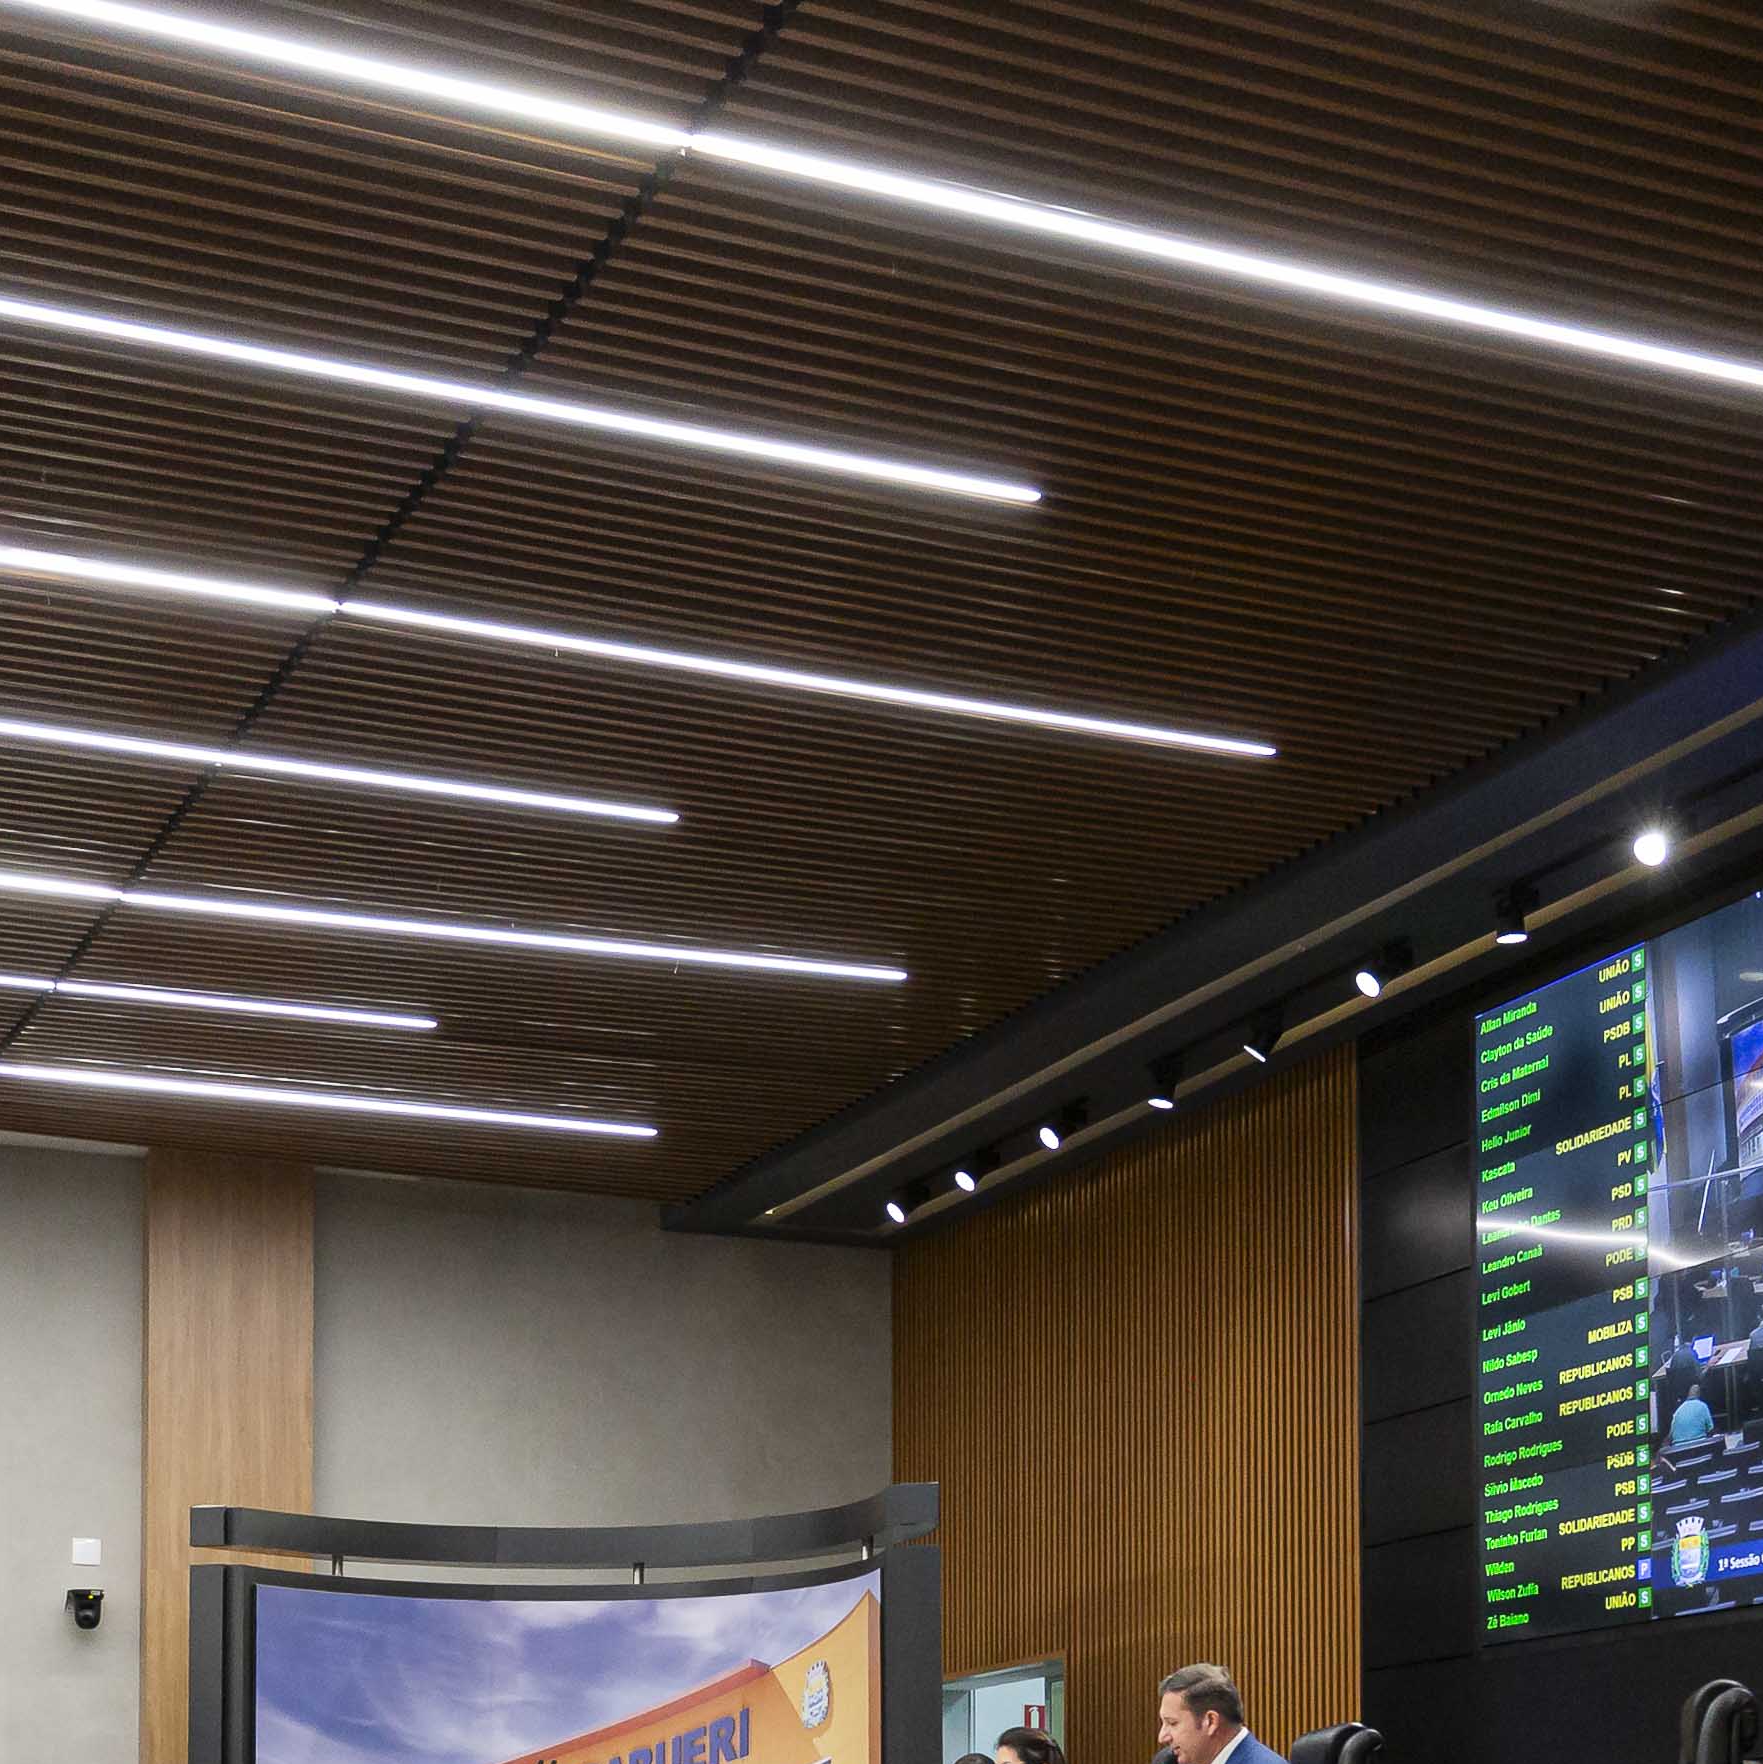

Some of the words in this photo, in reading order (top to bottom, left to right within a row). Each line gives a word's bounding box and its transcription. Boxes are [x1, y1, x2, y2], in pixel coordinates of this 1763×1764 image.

[1598, 959, 1629, 982] UNIÃO
[1599, 990, 1630, 1013] UNIÃO
[1503, 1001, 1538, 1025] Miranda
[1603, 1021, 1630, 1043] PSDB
[1481, 1042, 1512, 1063] Clayton
[1514, 1037, 1524, 1050] da
[1526, 1024, 1554, 1045] Saúde
[1619, 1053, 1631, 1068] PL
[1481, 1078, 1498, 1093] Cris
[1500, 1072, 1511, 1085] da
[1512, 1054, 1549, 1080] Maternal
[1619, 1084, 1631, 1100] PL
[1481, 1099, 1520, 1123] Edmilson
[1556, 1117, 1631, 1155] SOLIDARIEDADE
[1618, 1149, 1631, 1166] PV
[1482, 1162, 1516, 1183] Kascata
[1500, 1187, 1533, 1207] Oliveira
[1612, 1183, 1632, 1201] PSD
[1531, 1209, 1561, 1227] Dantas
[1612, 1214, 1632, 1232] PRD
[1482, 1255, 1516, 1275] Leandro
[1606, 1248, 1633, 1267] PODE
[1482, 1288, 1500, 1305] Levi
[1501, 1280, 1531, 1298] Gobert
[1613, 1285, 1633, 1303] PSB
[1483, 1325, 1501, 1341] Levi
[1588, 1320, 1632, 1344] MOBILIZA
[1506, 1349, 1538, 1366] Sabesp
[1559, 1353, 1632, 1384] REPUBLICANOS
[1559, 1386, 1633, 1416] REPUBLICANOS
[1484, 1420, 1503, 1435] Rafa
[1505, 1411, 1543, 1430] Carvalho
[1607, 1420, 1634, 1439] PODE
[1484, 1450, 1517, 1467] Rodrigo
[1519, 1440, 1563, 1459] Rodrigues
[1607, 1451, 1634, 1470] PSDB
[1615, 1480, 1635, 1496] PSB
[1484, 1509, 1513, 1523] Thiago
[1515, 1499, 1559, 1518] Rodrigues
[1559, 1508, 1635, 1535] SOLIDARIEDADE
[1485, 1534, 1518, 1550] Toninho
[1621, 1537, 1635, 1551] PP
[1718, 1558, 1729, 1571] 1ª
[1730, 1553, 1760, 1570] Sessão
[1561, 1565, 1635, 1590] REPUBLICANOS
[1487, 1588, 1515, 1602] Wilson
[1605, 1592, 1636, 1609] UNIÃO
